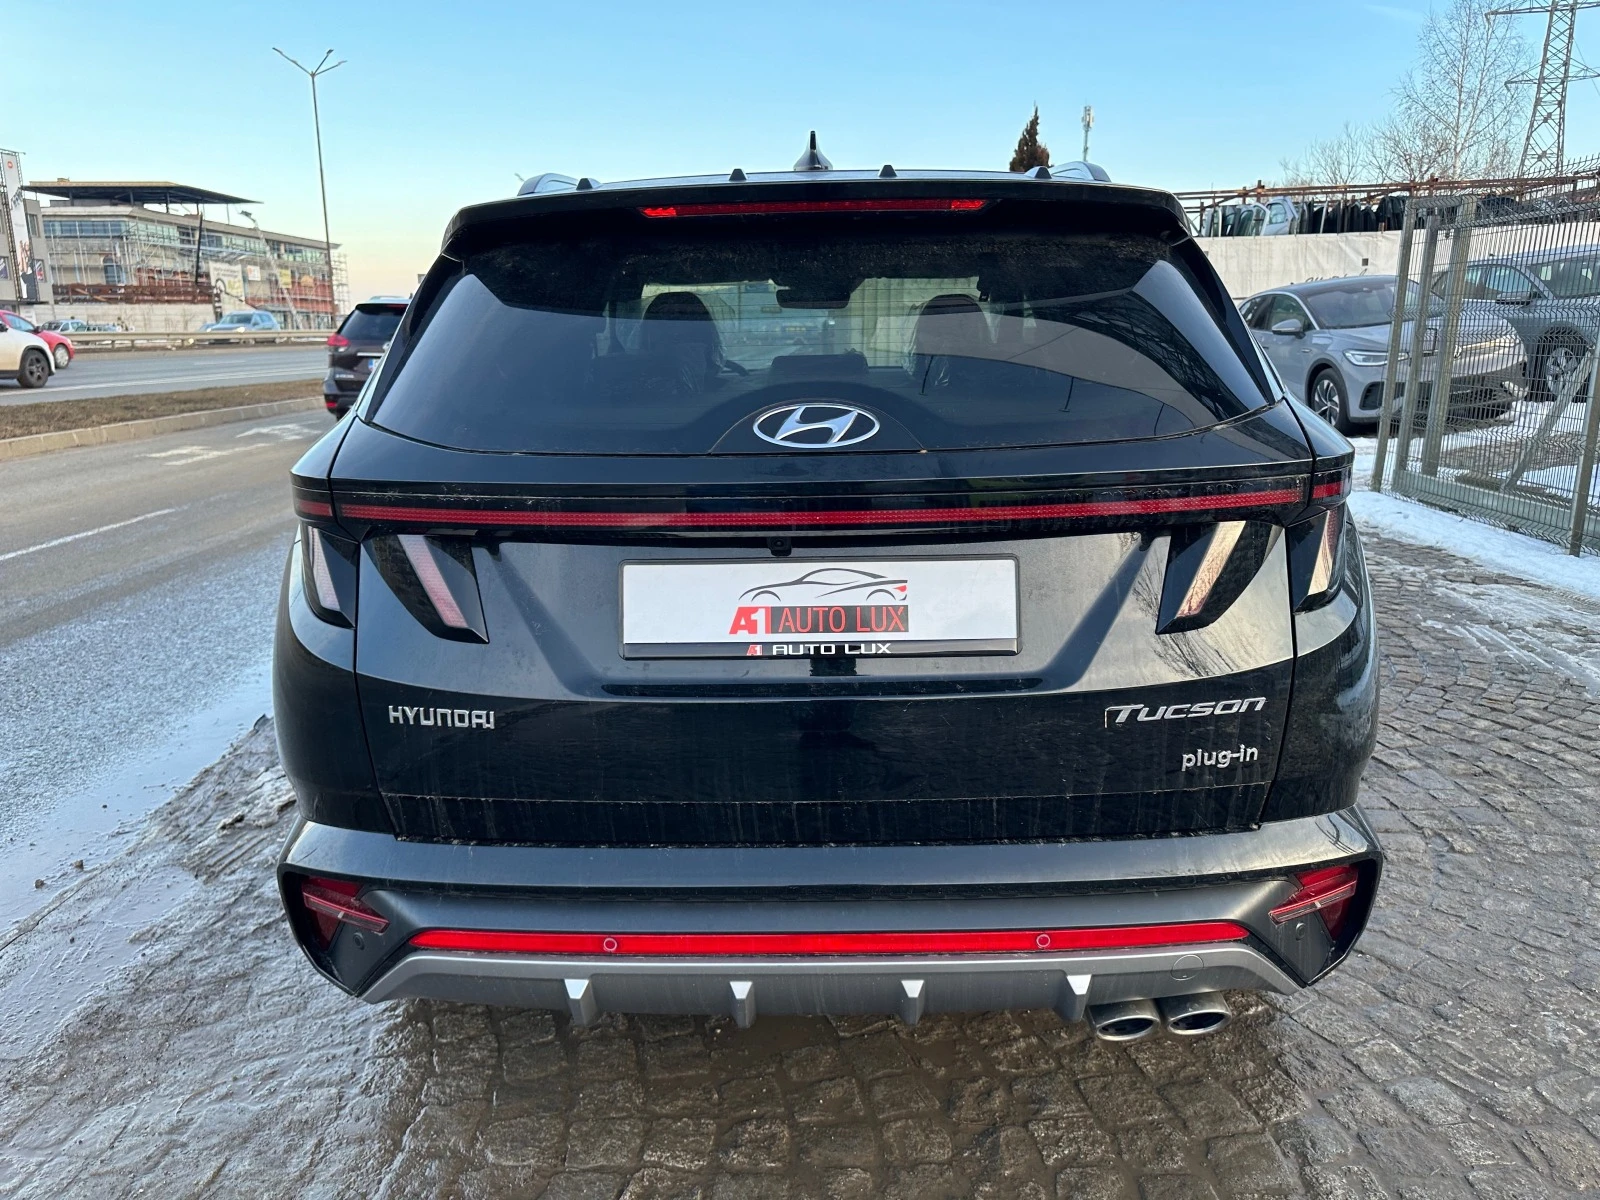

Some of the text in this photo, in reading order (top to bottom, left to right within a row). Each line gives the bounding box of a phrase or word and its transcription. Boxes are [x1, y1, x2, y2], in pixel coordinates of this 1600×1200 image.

[729, 606, 906, 635] A1 AUTO LUX
[746, 643, 892, 656] A1 AUTO LUX
[388, 705, 495, 730] HYUNDAI
[1181, 744, 1259, 772] plug-in
